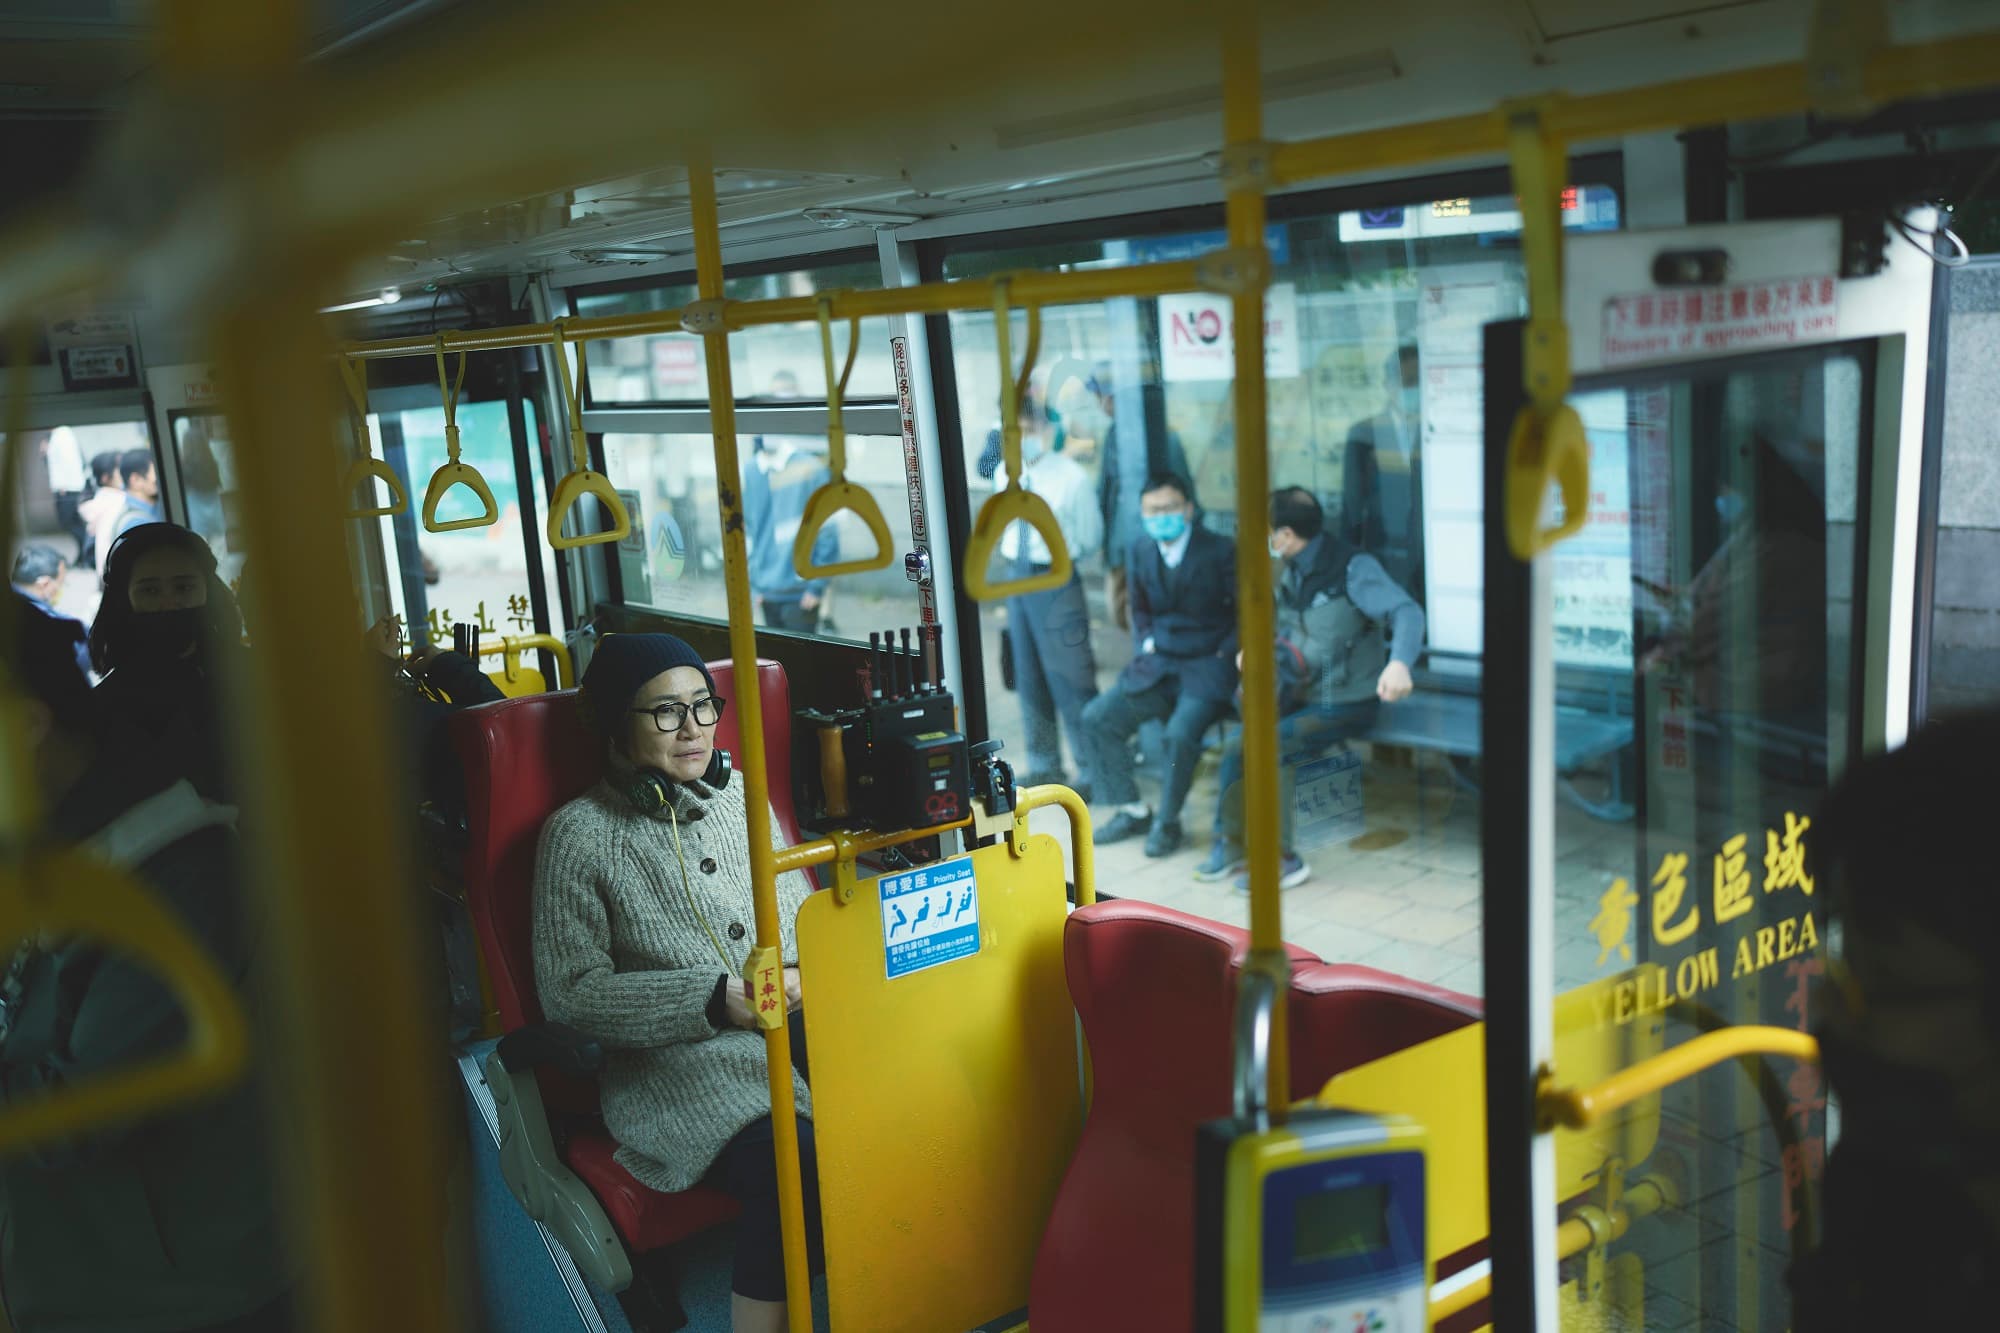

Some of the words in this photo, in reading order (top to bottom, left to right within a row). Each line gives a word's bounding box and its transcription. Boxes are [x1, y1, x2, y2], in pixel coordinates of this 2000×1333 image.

[884, 873, 928, 896] 博愛座
[933, 872, 955, 884] Priority
[957, 868, 971, 878] Seat
[1588, 811, 1814, 967] 黃色區域
[758, 967, 777, 1012] 下車鈴
[1592, 946, 1719, 1029] YELLOW
[1732, 910, 1819, 979] AREA
